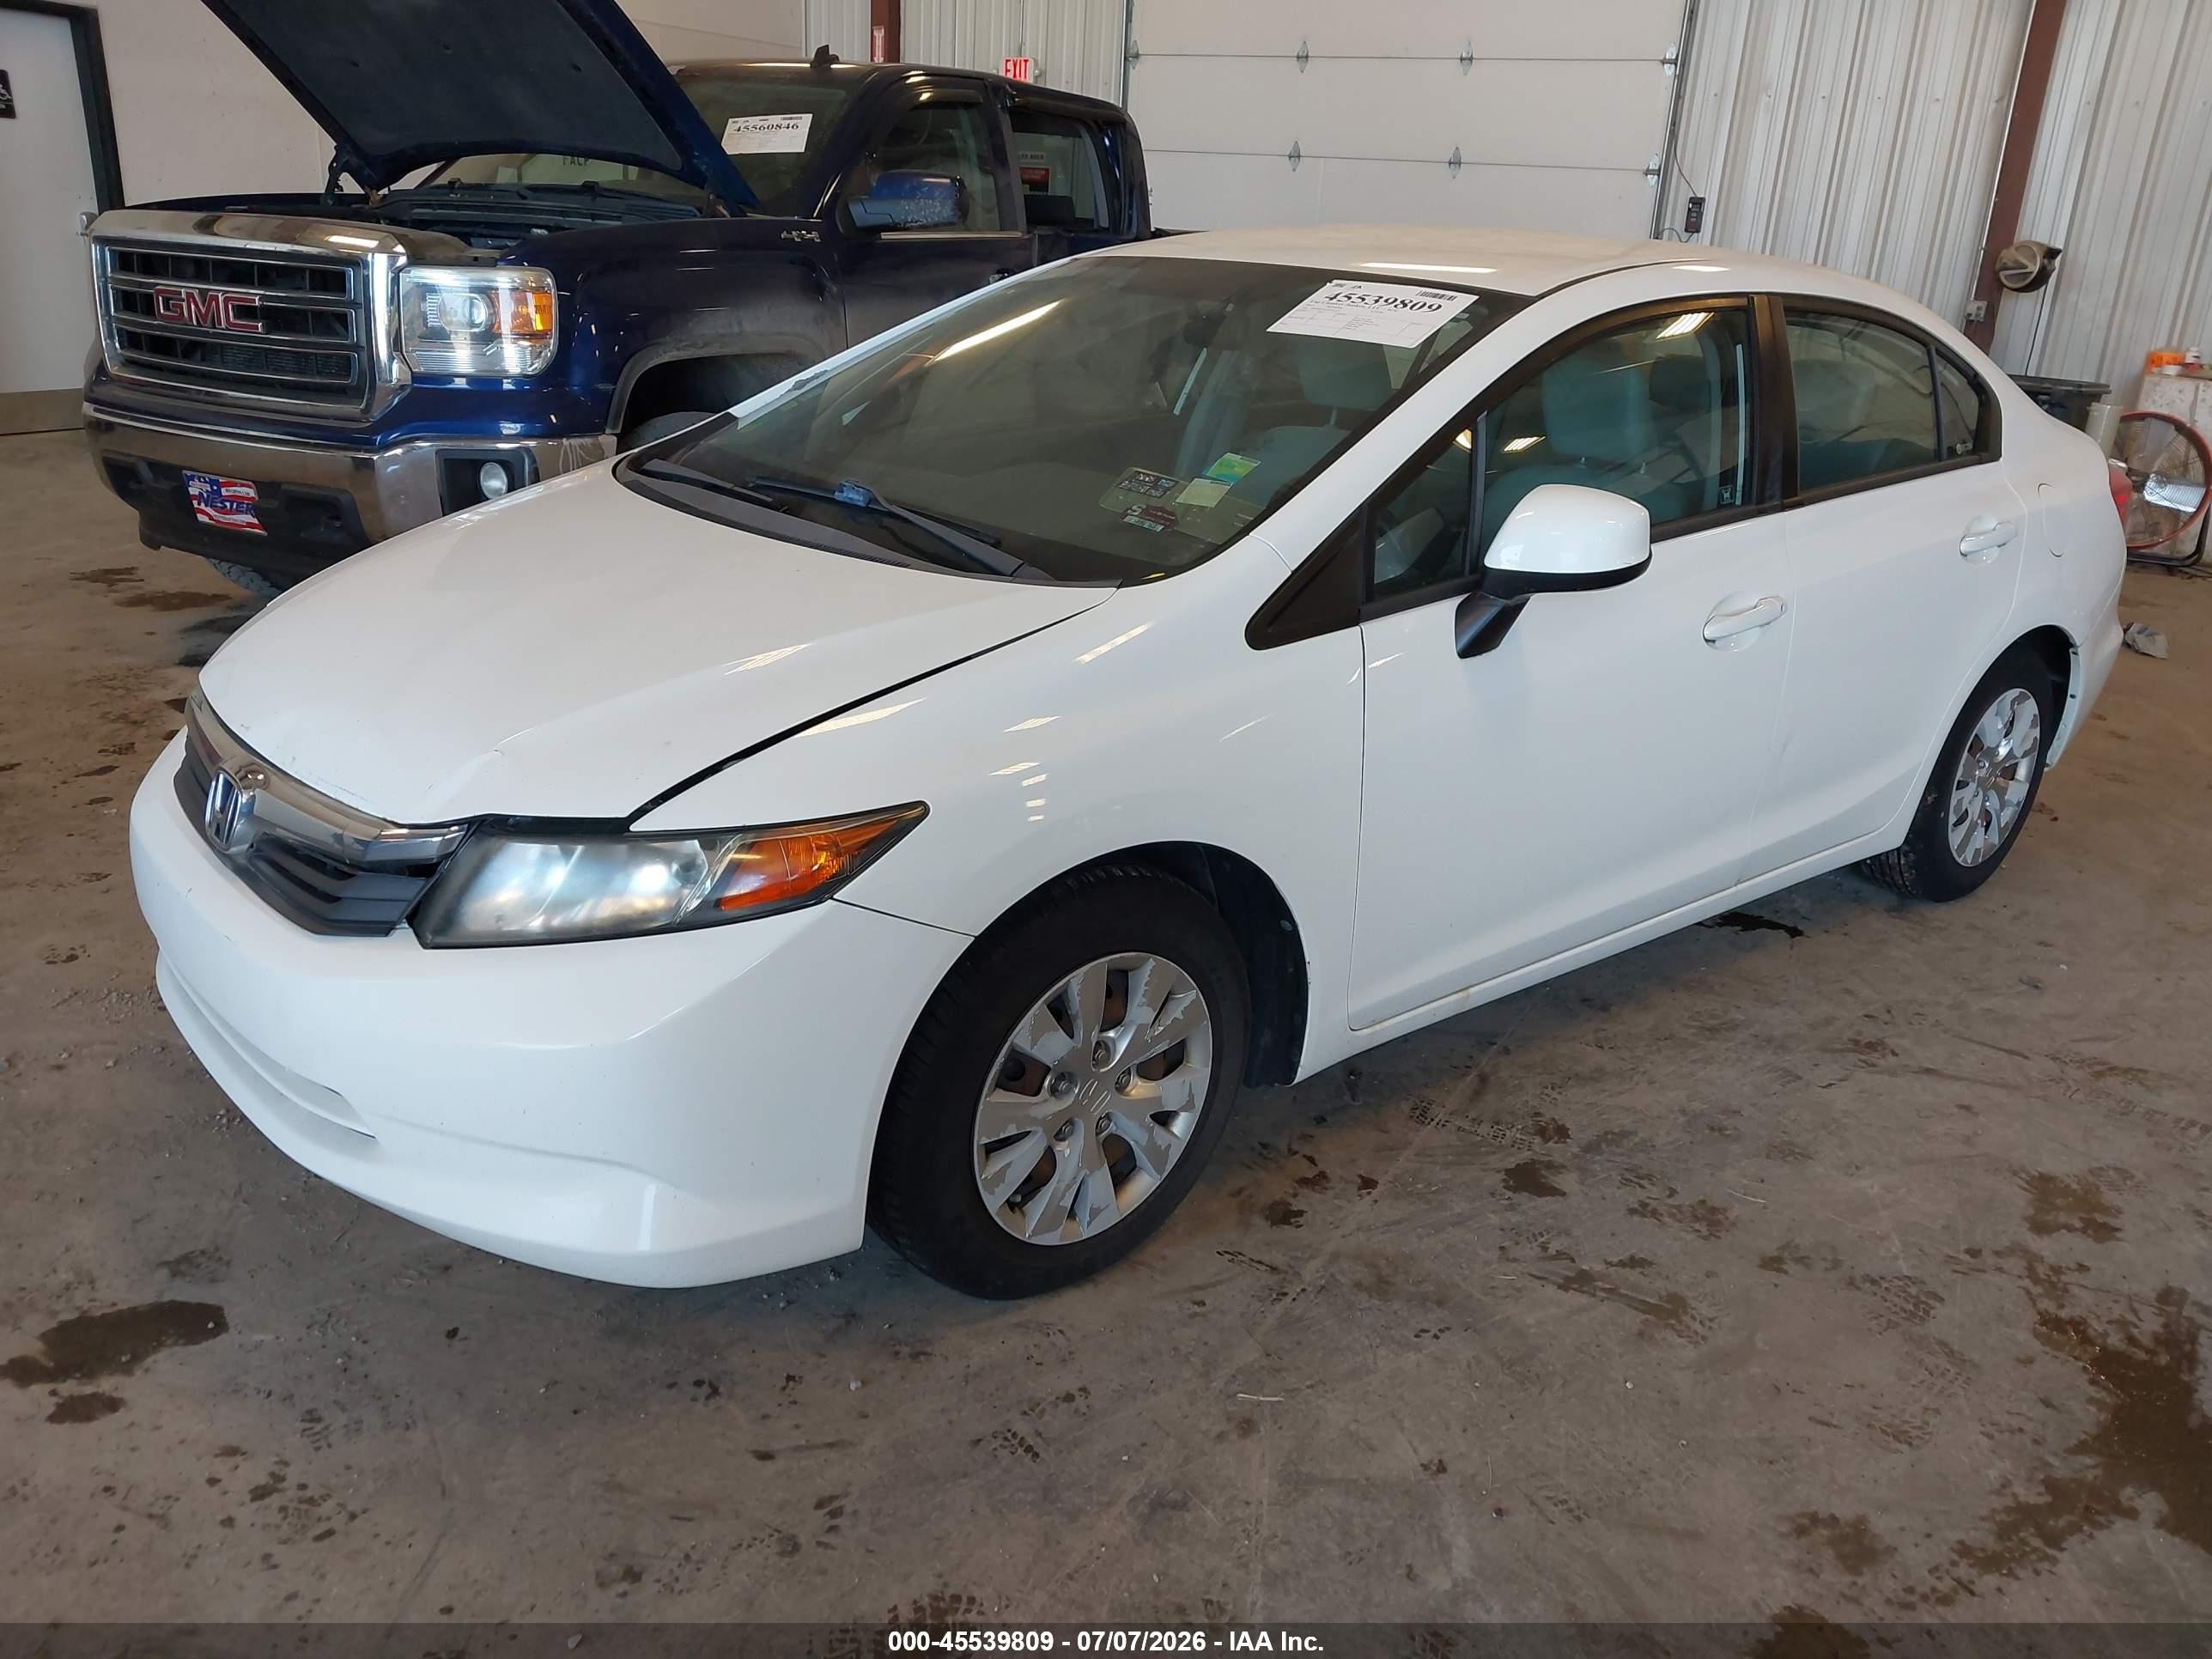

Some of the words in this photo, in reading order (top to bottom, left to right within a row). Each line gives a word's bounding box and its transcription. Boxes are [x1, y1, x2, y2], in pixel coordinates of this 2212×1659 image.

[1005, 58, 1029, 79] EXIT
[733, 123, 799, 132] 45560846
[154, 285, 262, 333] GMC
[1324, 291, 1443, 313] 45539809
[197, 490, 256, 519] NESTER
